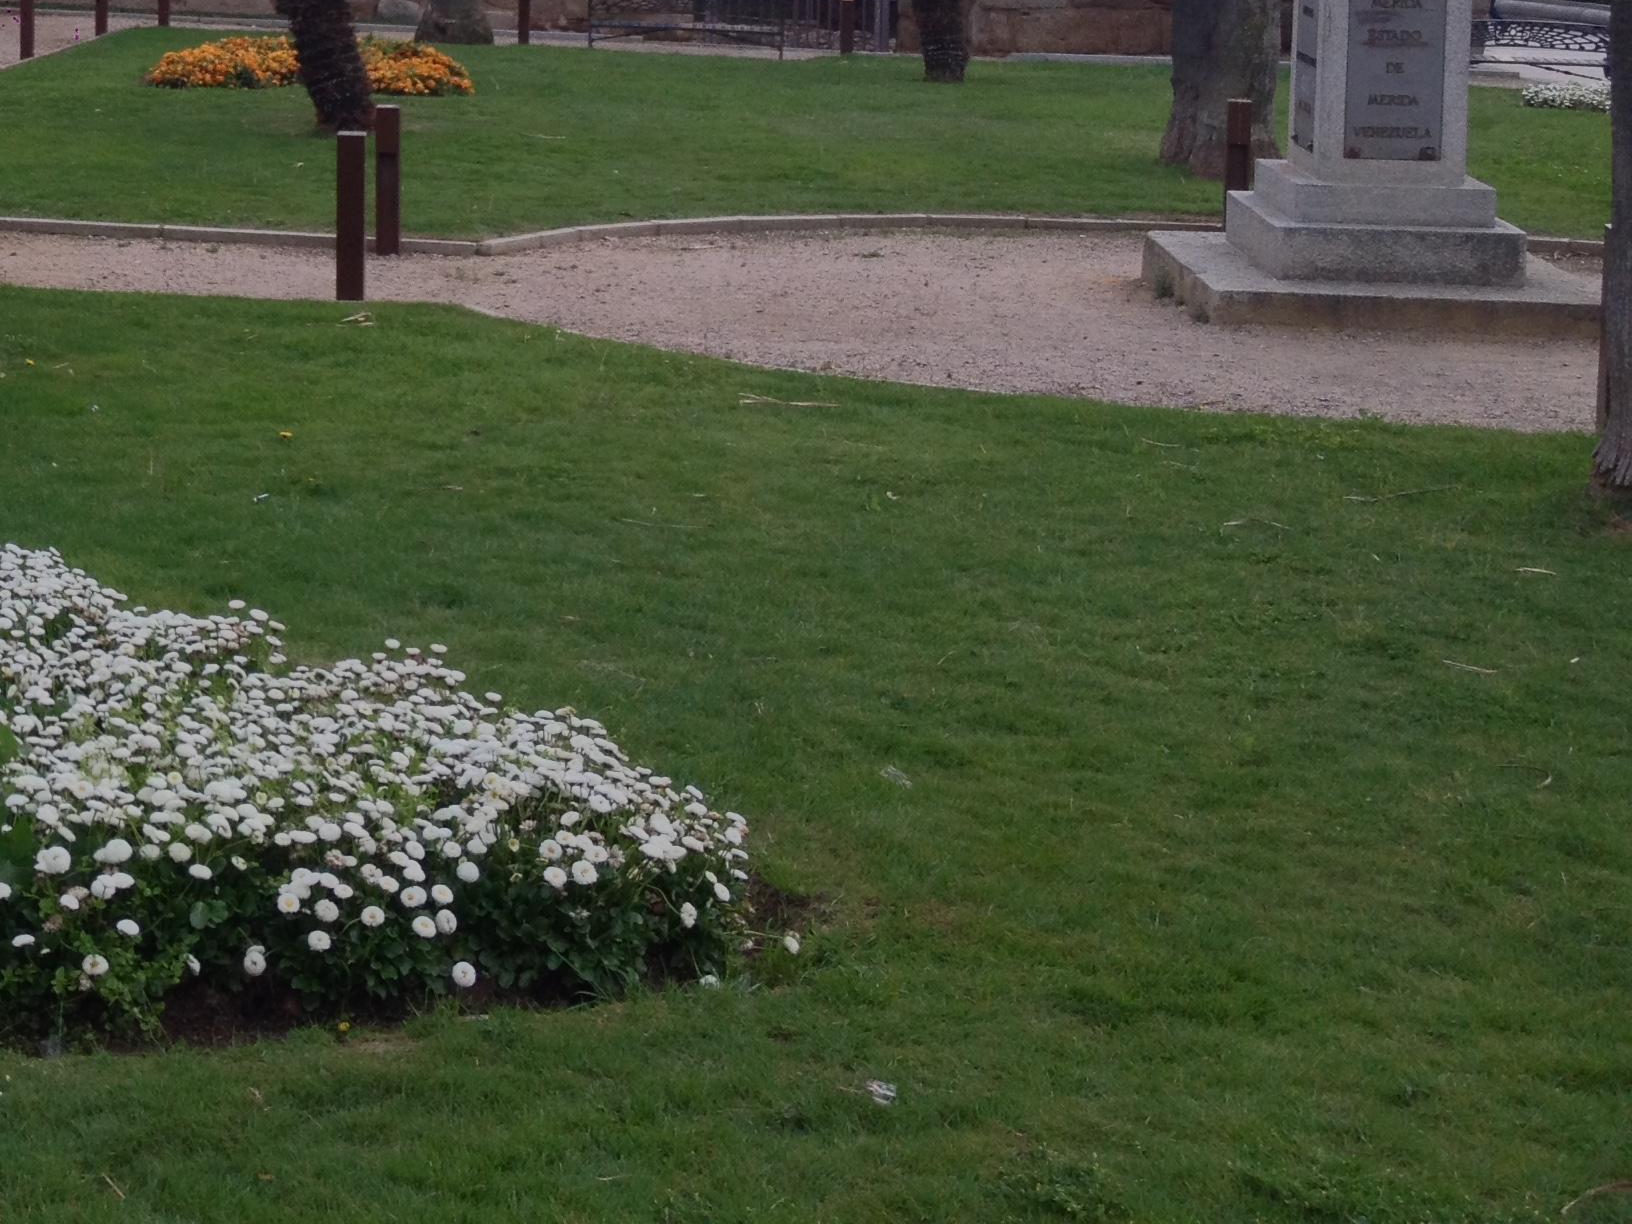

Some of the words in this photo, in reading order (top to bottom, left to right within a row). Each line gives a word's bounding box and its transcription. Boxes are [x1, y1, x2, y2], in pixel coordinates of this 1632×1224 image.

[1385, 62, 1406, 74] DE
[1367, 94, 1420, 106] MERIDA
[1353, 126, 1433, 139] VENEZUELA
